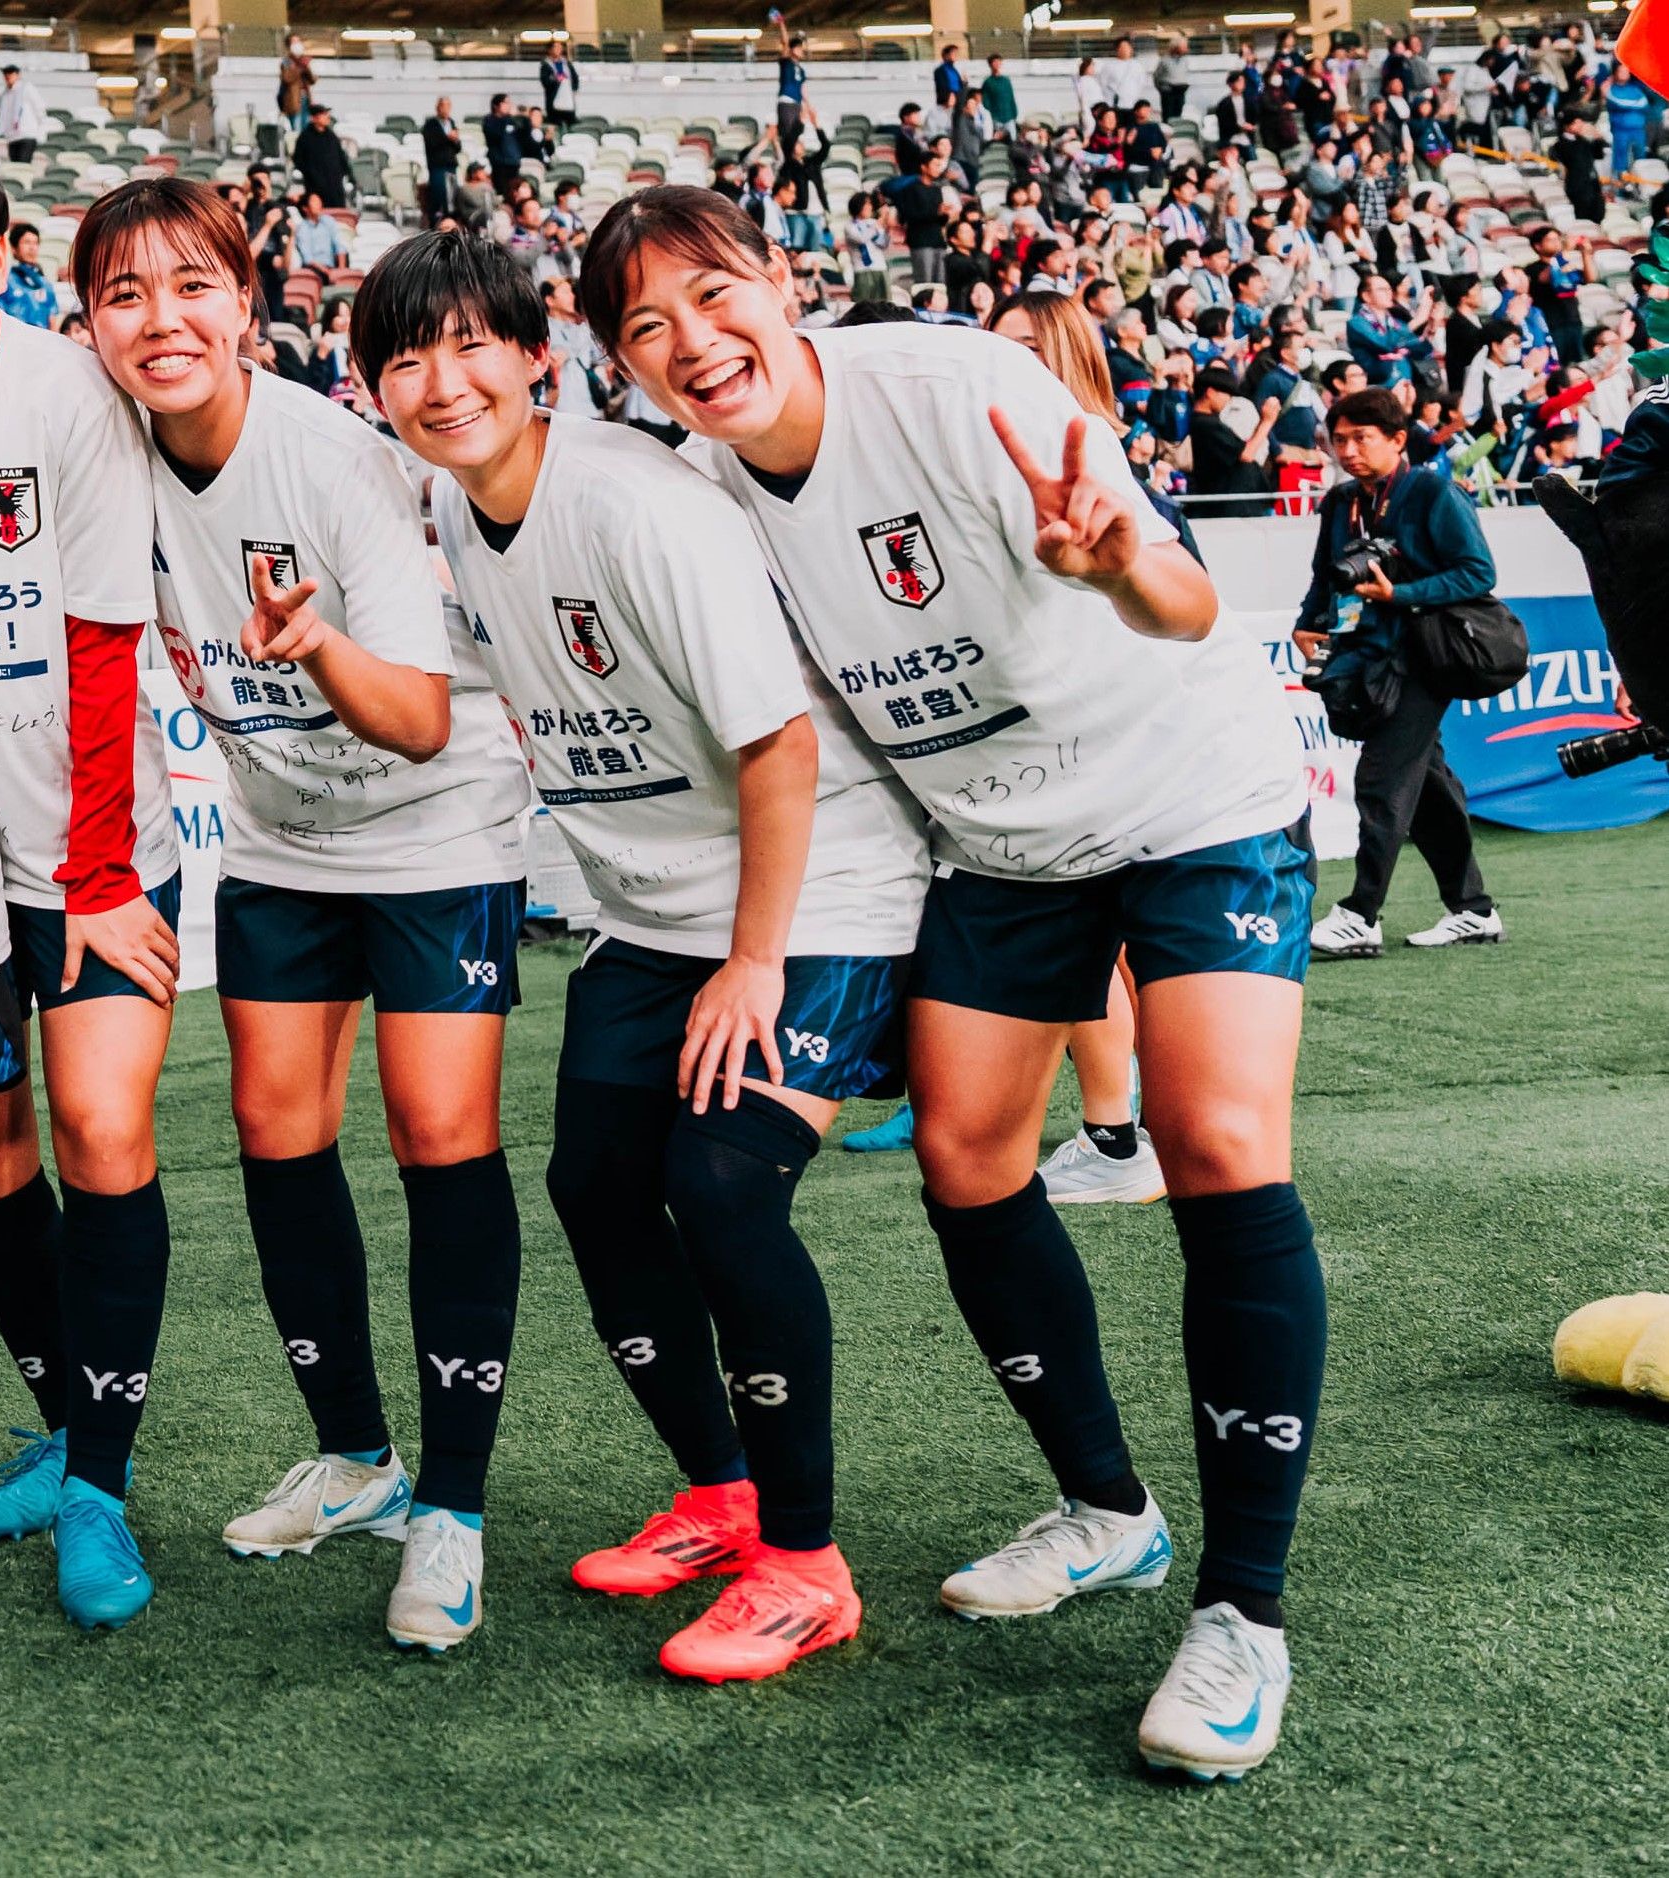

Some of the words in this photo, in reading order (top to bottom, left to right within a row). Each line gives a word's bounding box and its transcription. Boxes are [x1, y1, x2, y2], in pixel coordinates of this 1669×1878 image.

[873, 517, 907, 535] JAPAN
[251, 542, 283, 553] JAPAN
[838, 636, 985, 695] がんばろう
[231, 676, 308, 708] 能登!
[884, 681, 981, 730] 能登!
[529, 706, 653, 738] がんばろう
[566, 743, 649, 777] 能登!
[1224, 911, 1280, 945] Y-3
[459, 958, 498, 986] Y-3
[783, 1026, 830, 1064] Y-3
[17, 1356, 46, 1379] 3
[82, 1364, 149, 1403] Y-3
[427, 1352, 505, 1393] Y-3
[1202, 1401, 1304, 1453] Y-3
